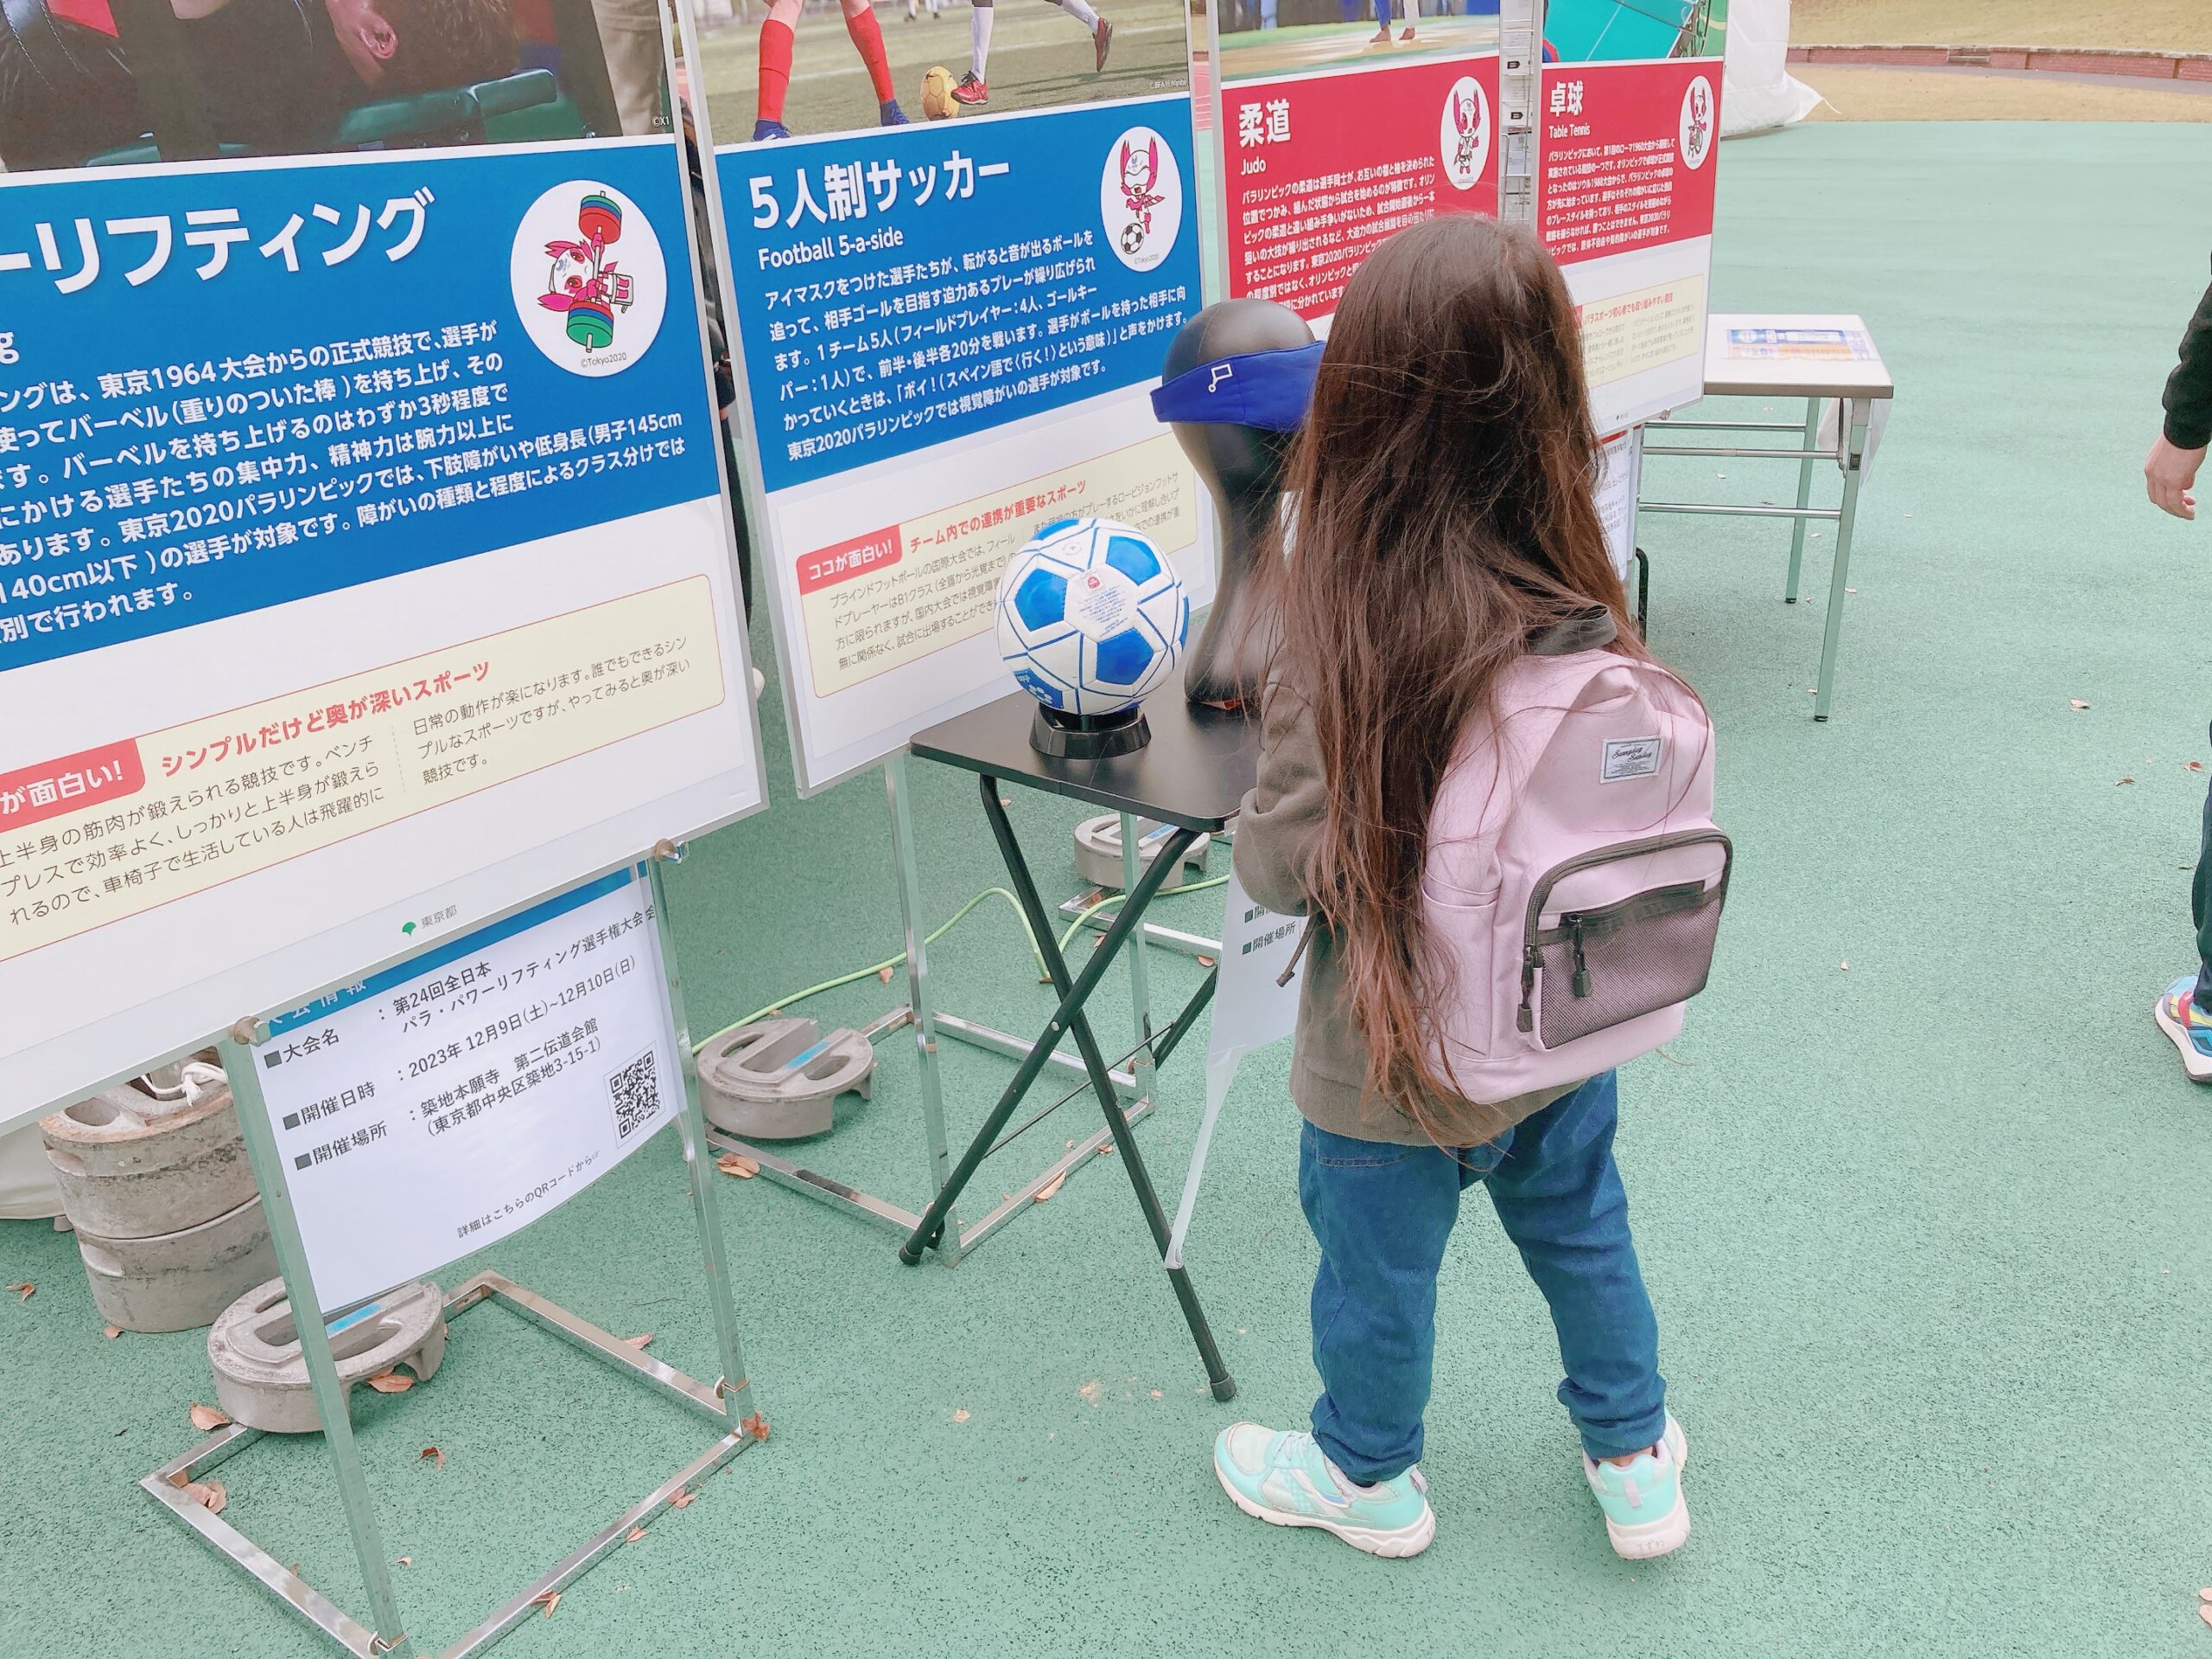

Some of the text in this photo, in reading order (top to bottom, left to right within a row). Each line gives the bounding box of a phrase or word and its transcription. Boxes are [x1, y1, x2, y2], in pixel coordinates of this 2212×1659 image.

[1549, 80, 1584, 118] 卓球
[1239, 98, 1291, 149] 柔道
[1548, 122, 1591, 138] Table Tennis
[750, 149, 1011, 231] 5人制サッカー
[1240, 156, 1267, 176] Judo
[758, 227, 905, 270] Football 5-a-side
[765, 229, 1094, 311] アイマスクをつけた選手たちが、転がると音が出るボールを
[580, 352, 627, 369] ©Tokyo2020
[787, 359, 1106, 461] 東京2020パラリンピックでは視覚障がいの選手が対象です。
[809, 480, 1086, 581] ココが面白い! チーム内での連携が重要なスポーツ
[412, 636, 689, 737] 日常の動作が楽になります。誰でもできるシン
[416, 658, 690, 760] プルなスポーツですが、やってみると奥が深い
[162, 661, 490, 778] シンプルだけど奥が深いスポーツ
[422, 753, 489, 786] 競技です。
[0, 760, 380, 898] プレスで効率よく、しっかりと上半身が鍛えら
[10, 786, 385, 926] れるので、車椅子で生活している人は飛躍的に
[421, 904, 459, 929] 東京都
[283, 1028, 340, 1064] 大会名
[301, 1080, 378, 1126] 開催日時
[312, 1121, 388, 1166] 開催場所
